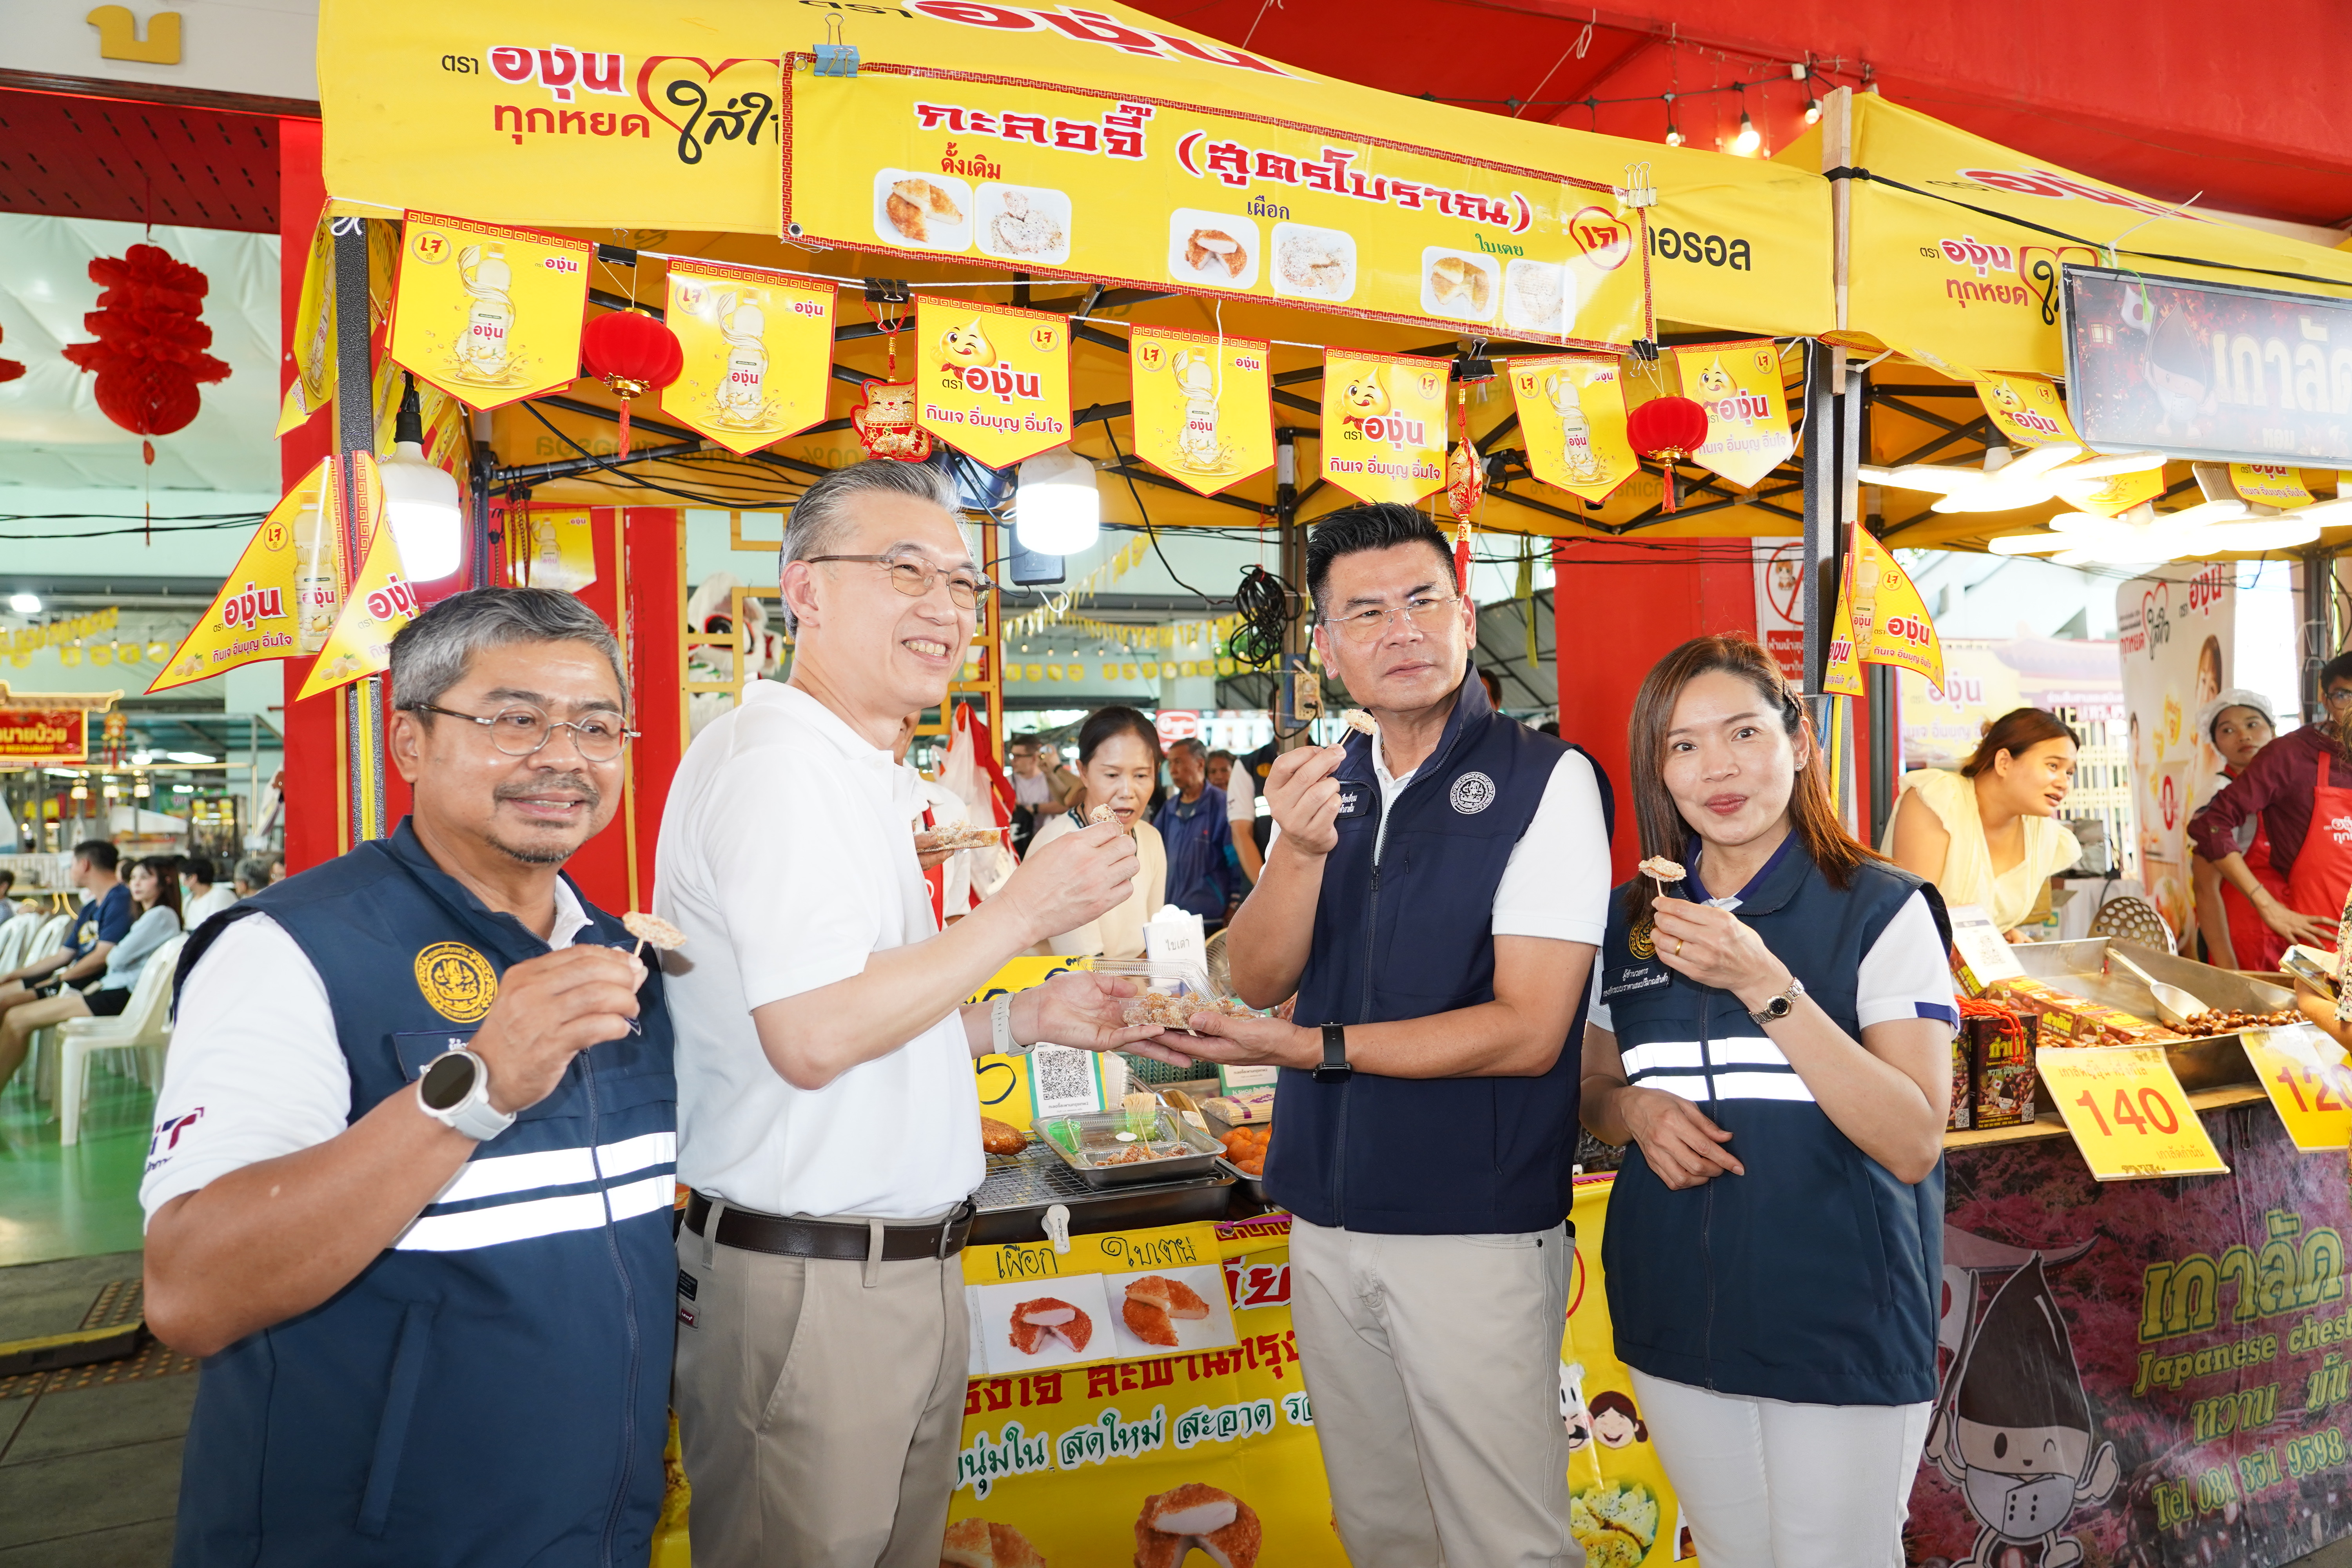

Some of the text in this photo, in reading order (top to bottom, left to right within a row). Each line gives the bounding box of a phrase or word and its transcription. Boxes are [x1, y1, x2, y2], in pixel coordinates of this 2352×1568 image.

[901, 0, 1323, 84] องุ่น
[441, 44, 630, 103] ตรา องุ่น
[495, 105, 650, 145] ทุกหยด
[941, 142, 1002, 180] ดั้งเดิม
[1247, 194, 1290, 220] เผือก
[1475, 233, 1524, 257] ใบเตย
[1920, 234, 2016, 278] ตรา องุ่น
[544, 256, 579, 274] องุ่น
[794, 300, 826, 318] องุ่น
[1946, 279, 2028, 309] ทุกหยด
[473, 322, 505, 340] องุ่น
[731, 369, 760, 387] องุ่น
[1236, 356, 1260, 372] องุ่น
[1594, 369, 1615, 383] องุ่น
[942, 361, 1045, 405] ตรา องุ่น
[926, 403, 1064, 434] กินเจ อิ่มบุญ อิ่มใจ
[1718, 388, 1773, 427] องุ่น
[2005, 408, 2065, 436] ตรา องุ่น
[1190, 418, 1213, 433] องุ่น
[1344, 408, 1428, 452] ตรา องุ่น
[1568, 434, 1588, 448] องุ่น
[1726, 434, 1760, 455] อิ่มบุญ
[1762, 430, 1787, 448] อิ่มใจ
[1329, 455, 1441, 481] กินเจ อิ่มบุญ อิ่มใจ
[2239, 484, 2307, 499] กินเจ อิ่มบุญ อิ่มใจ
[213, 581, 289, 633] ตรา องุ่น
[301, 586, 336, 608] องุ่น
[358, 618, 374, 630] ตรา
[1853, 614, 1871, 628] องุ่น
[1886, 613, 1931, 650] องุ่น
[212, 631, 293, 663] กินเจ อิ่มบุญ อิ่มใจ
[1874, 646, 1932, 669] กินเจ อิ่มบุญ อิ่มใจ
[2075, 1087, 2179, 1136] 140
[996, 1243, 1058, 1279] เผือก
[2138, 1209, 2345, 1343] เกาลัด
[2133, 1332, 2278, 1398] Japanese
[2192, 1383, 2279, 1444] หวาน
[957, 1426, 1045, 1495] นุ่มใน
[1061, 1409, 1162, 1465] สดใหม่
[1178, 1403, 1271, 1445] สะอาด
[2152, 1427, 2345, 1530] Tel 081 351 9598
